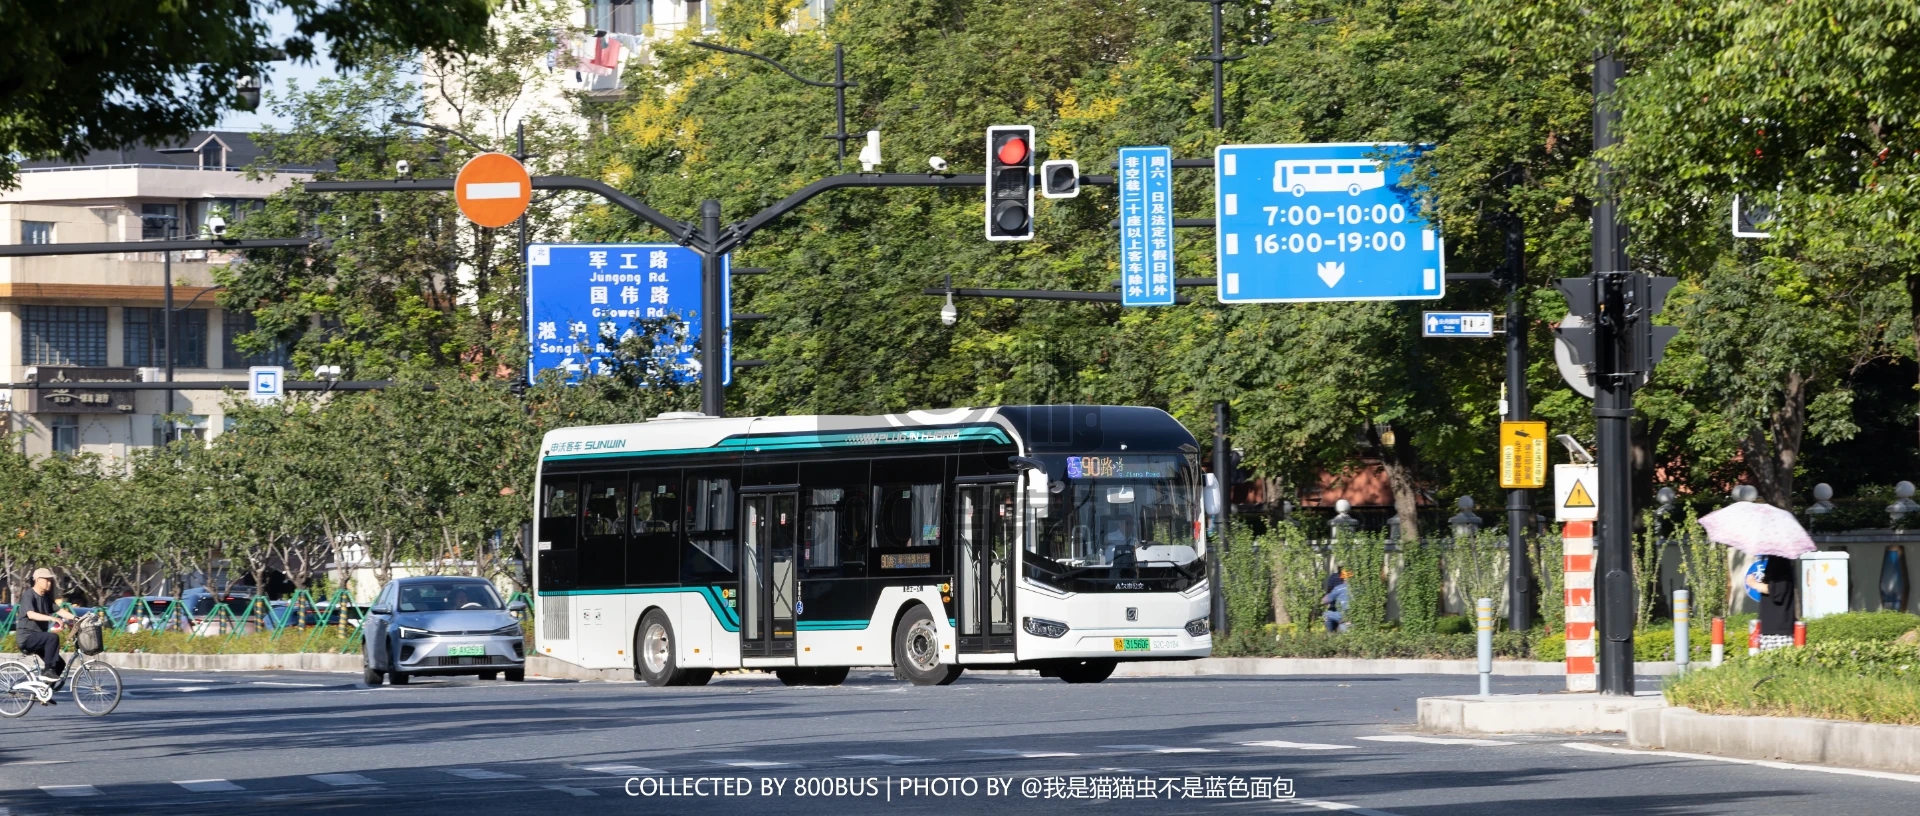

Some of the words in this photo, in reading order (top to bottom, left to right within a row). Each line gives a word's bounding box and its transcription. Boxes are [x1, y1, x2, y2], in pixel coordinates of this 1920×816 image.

[1263, 203, 1405, 226] 7:00-10:00
[1125, 156, 1143, 297] 非空载二十座以上客车除外
[1150, 156, 1168, 296] 周六、日及法定节假日除外
[1255, 231, 1406, 254] 16:00-19:00
[589, 250, 669, 269] 军工路
[589, 272, 641, 285] Jungong
[649, 272, 669, 283] Rd.
[590, 286, 669, 304] 国伟路
[647, 307, 667, 318] Rd.
[540, 342, 588, 356] Songh
[584, 438, 627, 450] SUNWIN
[921, 429, 960, 441] HYBRID
